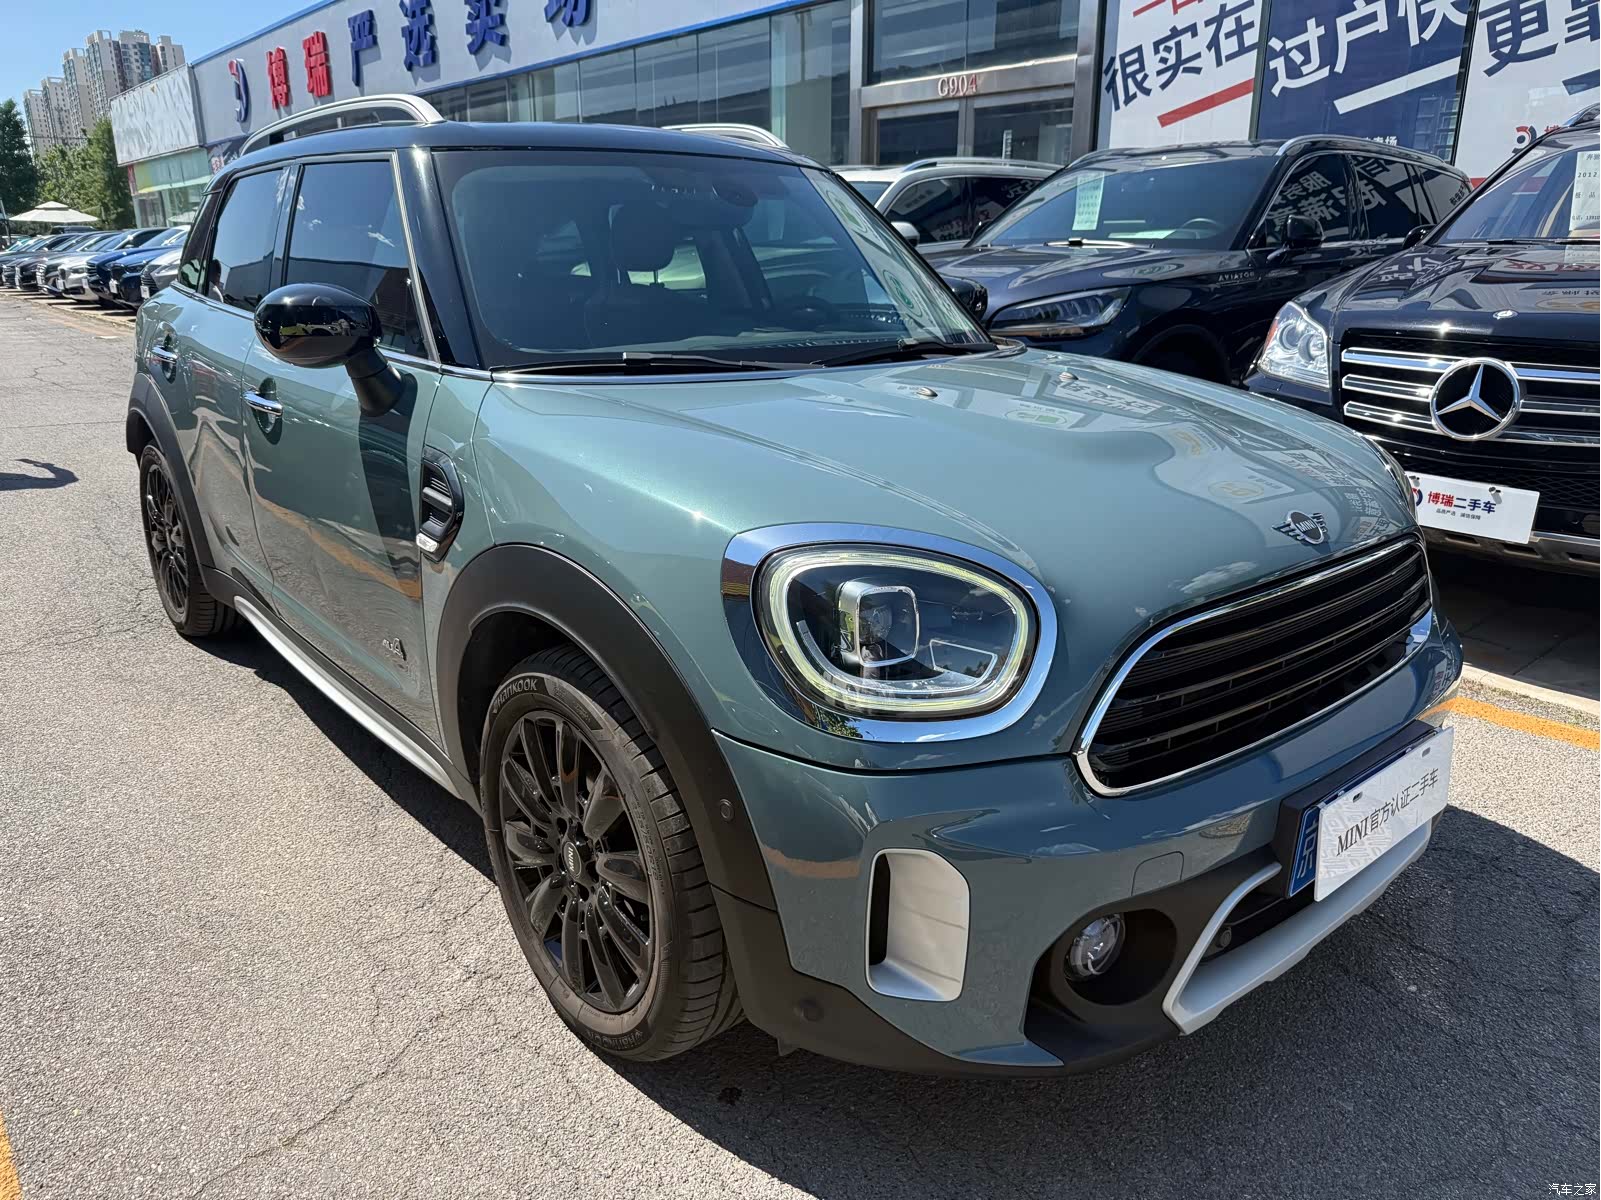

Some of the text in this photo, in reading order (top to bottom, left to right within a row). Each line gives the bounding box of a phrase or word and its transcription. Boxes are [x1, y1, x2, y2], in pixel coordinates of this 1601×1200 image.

[1104, 3, 1258, 112] 很实在
[1478, 0, 1600, 77] 更
[937, 74, 978, 97] G904
[1296, 519, 1317, 533] MINI
[1427, 490, 1497, 514] 博瑞二手车
[1336, 767, 1439, 858] MINI 官方认证二手车
